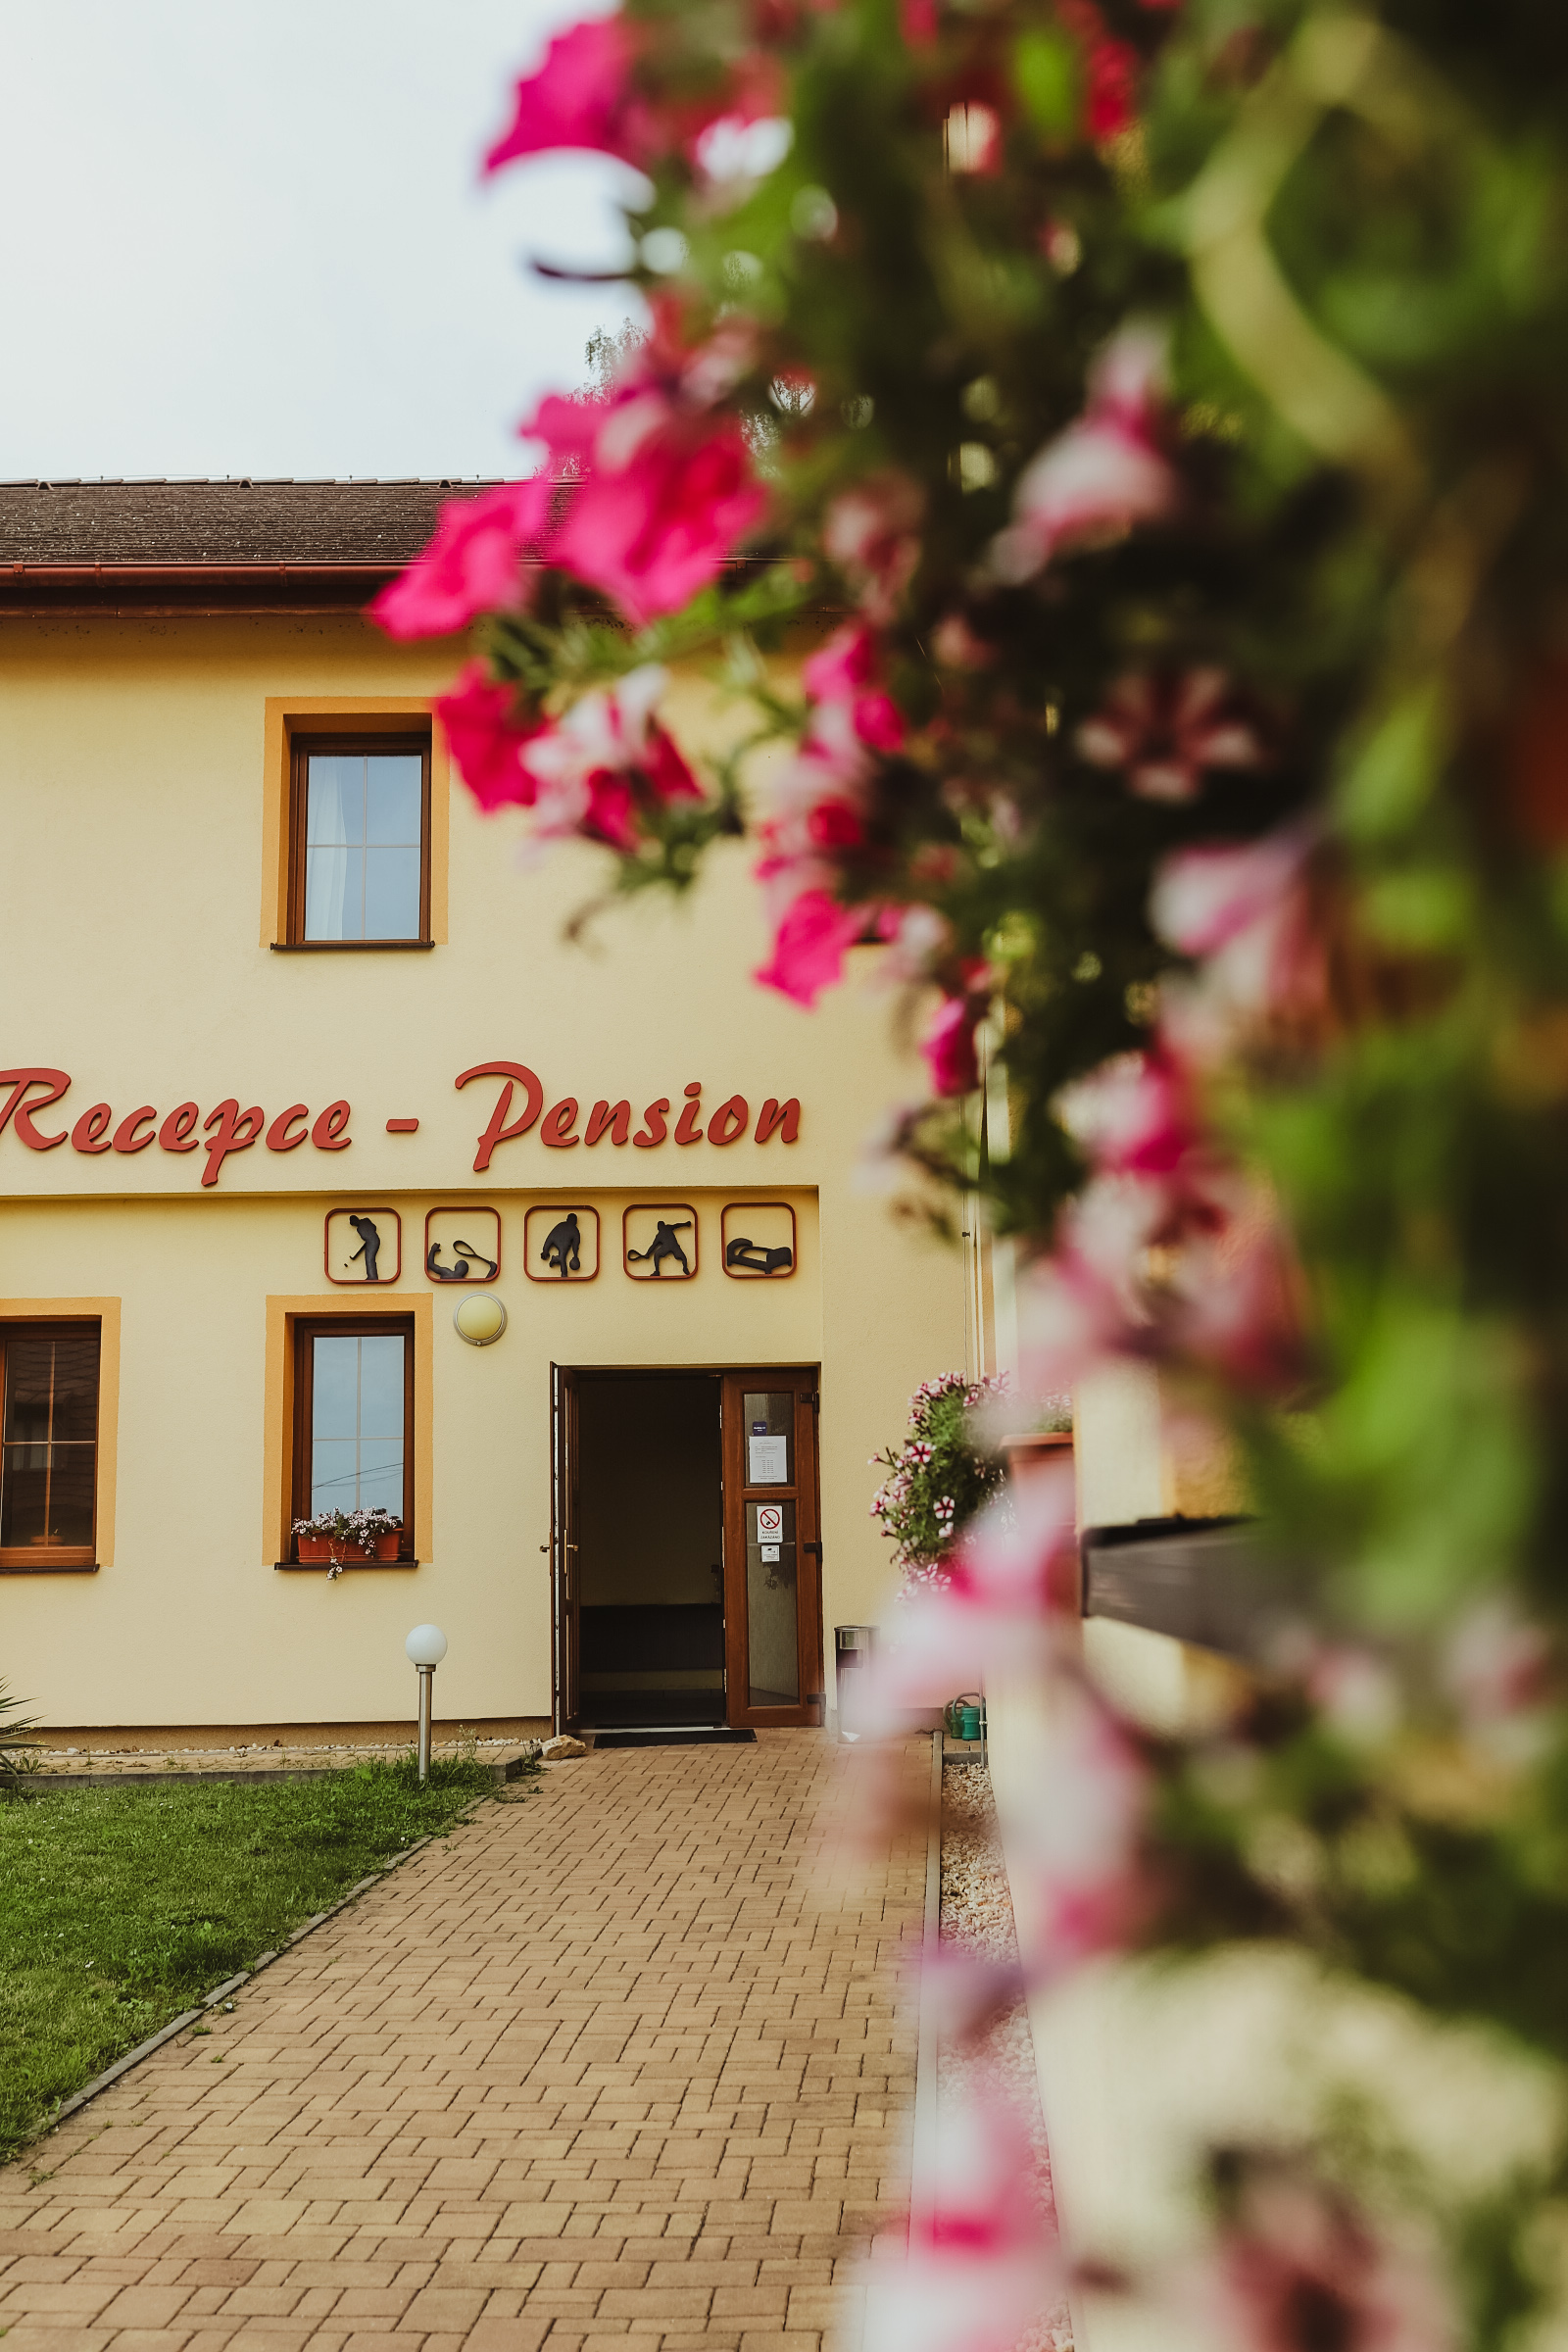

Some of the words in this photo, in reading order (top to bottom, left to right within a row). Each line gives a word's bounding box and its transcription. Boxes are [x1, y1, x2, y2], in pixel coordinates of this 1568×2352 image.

[0, 1067, 352, 1187] Recepce
[386, 1118, 419, 1132] -
[455, 1061, 801, 1172] Pension
